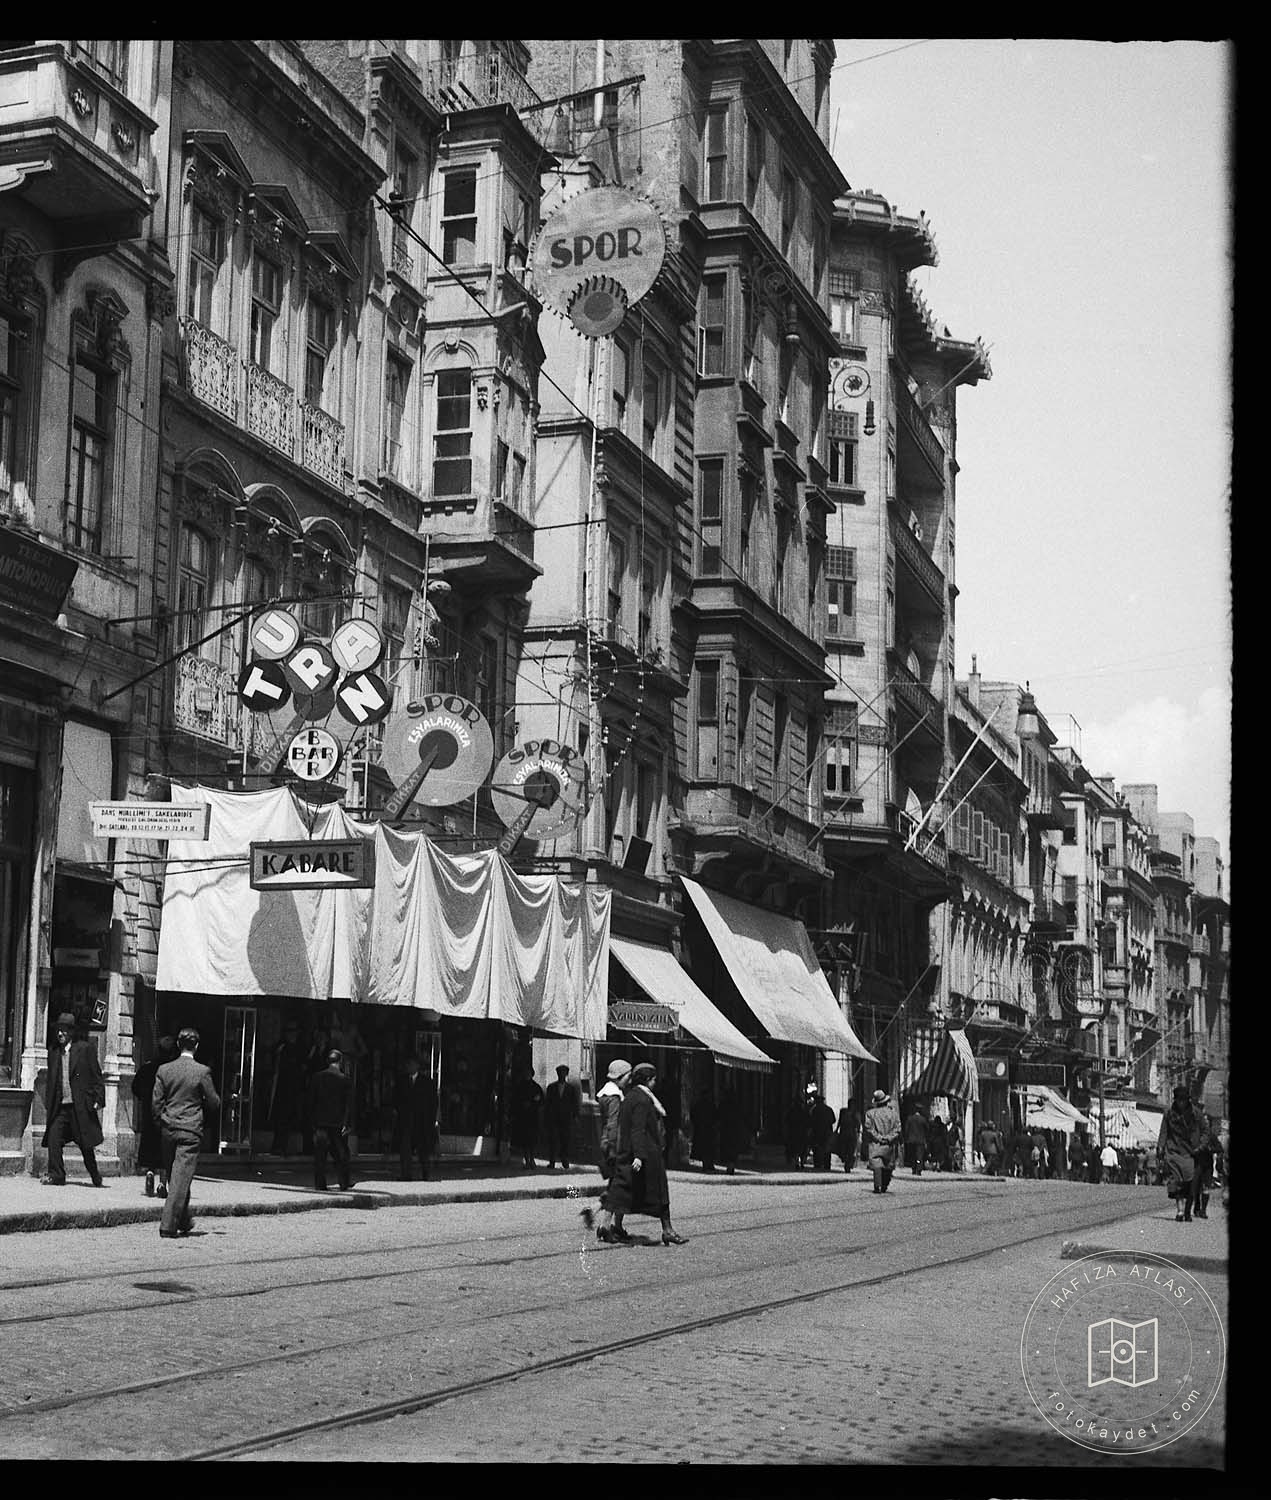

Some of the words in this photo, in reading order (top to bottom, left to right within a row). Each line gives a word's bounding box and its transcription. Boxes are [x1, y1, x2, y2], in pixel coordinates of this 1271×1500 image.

[550, 227, 643, 269] SPOR
[242, 611, 385, 723] TURAN
[406, 694, 480, 730] SPOR
[292, 747, 334, 760] BAR
[508, 739, 578, 769] SPOR
[262, 851, 355, 875] KABARE
